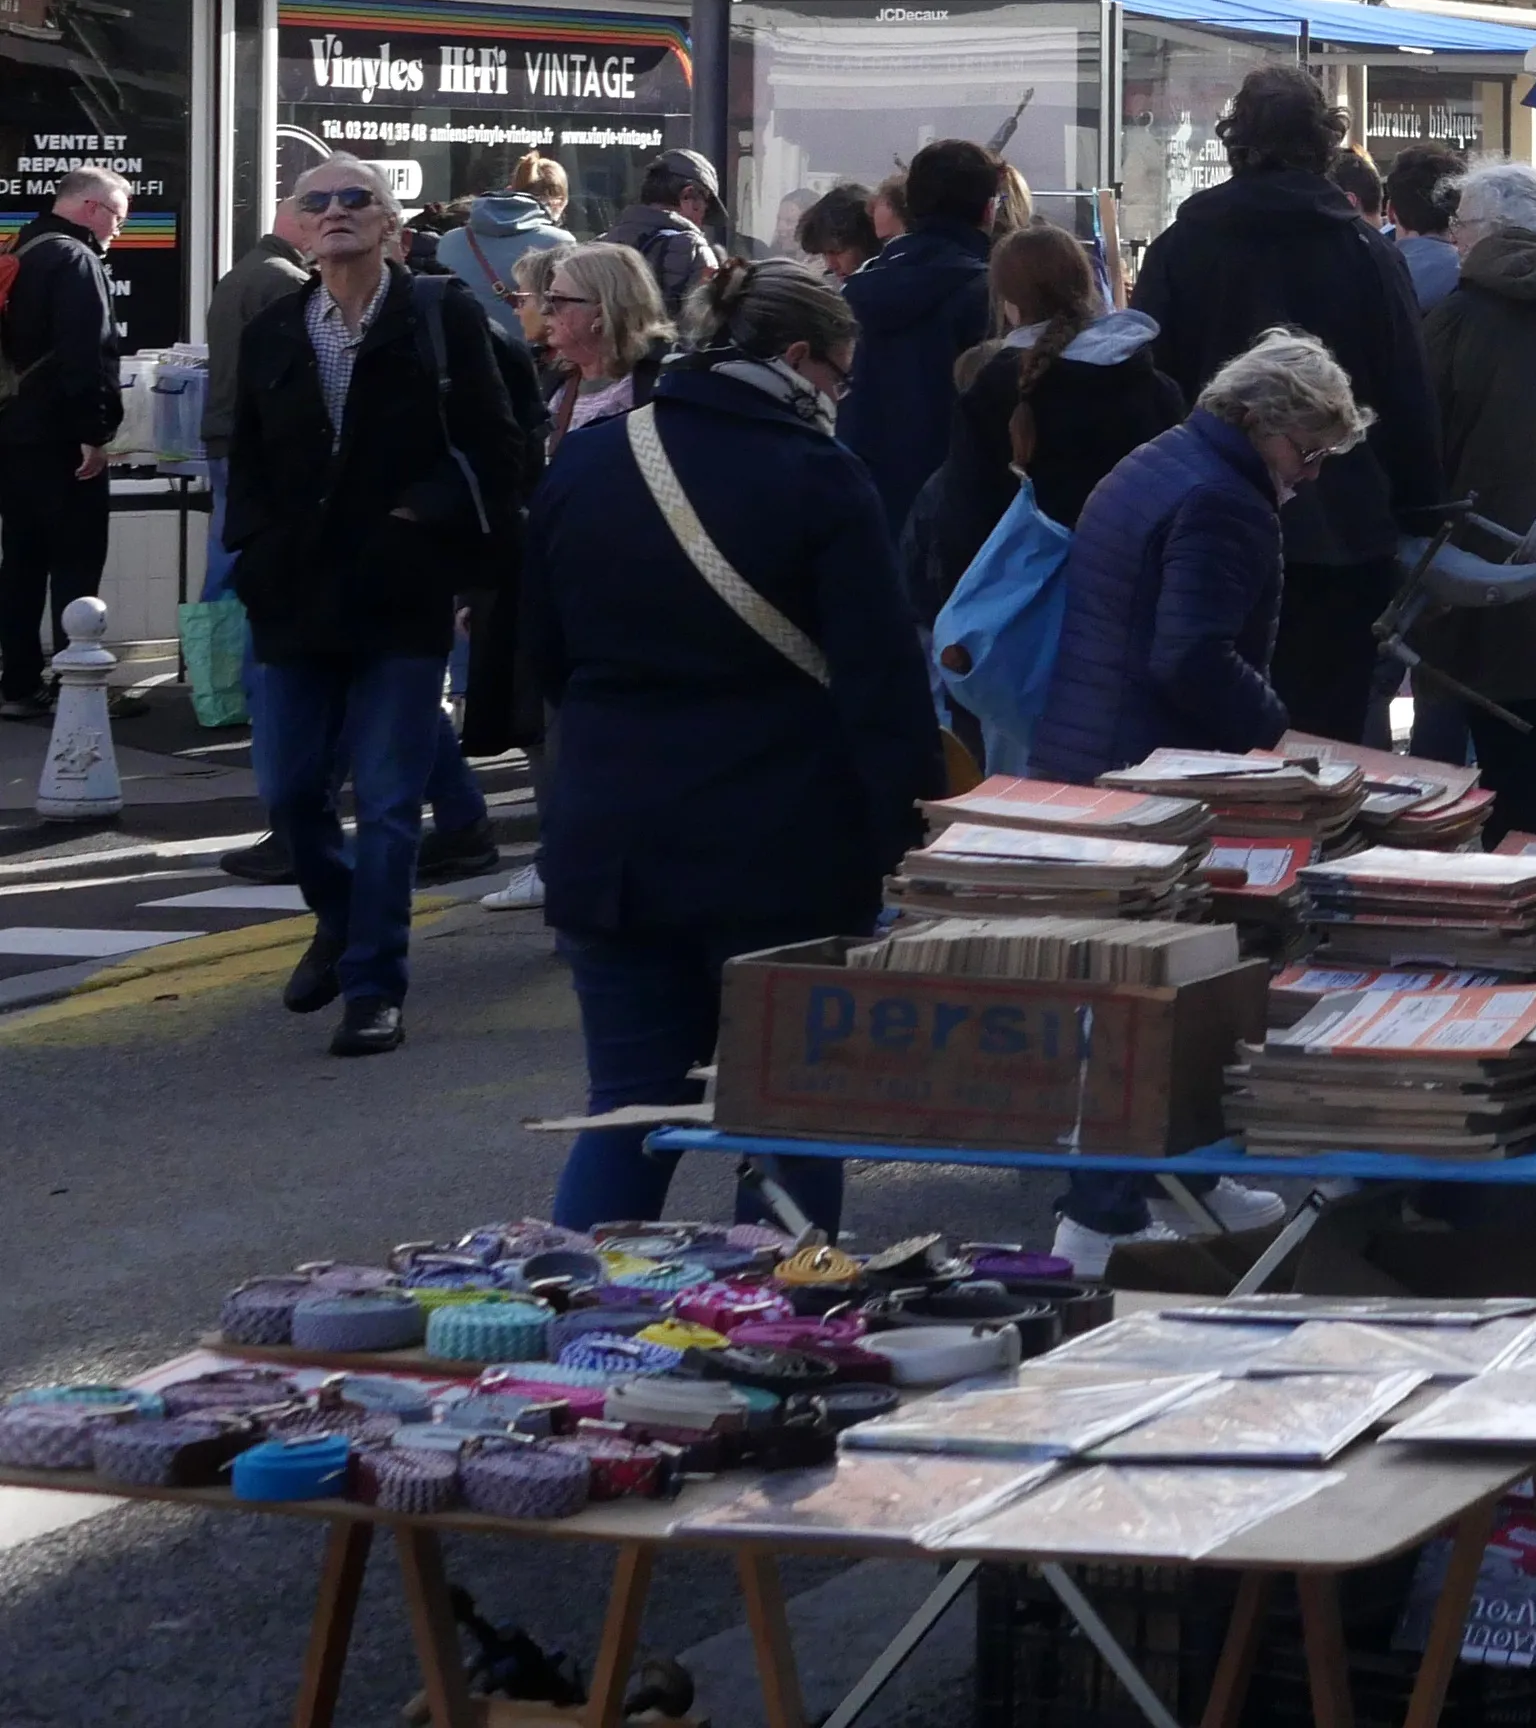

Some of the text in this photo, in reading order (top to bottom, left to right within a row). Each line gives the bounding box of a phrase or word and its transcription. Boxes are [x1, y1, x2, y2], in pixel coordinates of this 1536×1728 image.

[875, 8, 949, 22] JCDecaux
[310, 33, 423, 104] Vinyles
[525, 52, 636, 99] VINTAGE
[345, 120, 362, 140] 03
[363, 121, 378, 140] 22
[379, 122, 394, 141] 41
[395, 122, 410, 141] 35
[430, 123, 554, 148] amiens@vinyle-vintage.fr
[561, 126, 663, 150] www.vinyle-vintage.fr
[1428, 104, 1478, 149] biblique
[34, 134, 127, 150] VENTE ET
[17, 157, 142, 173] REPARATION
